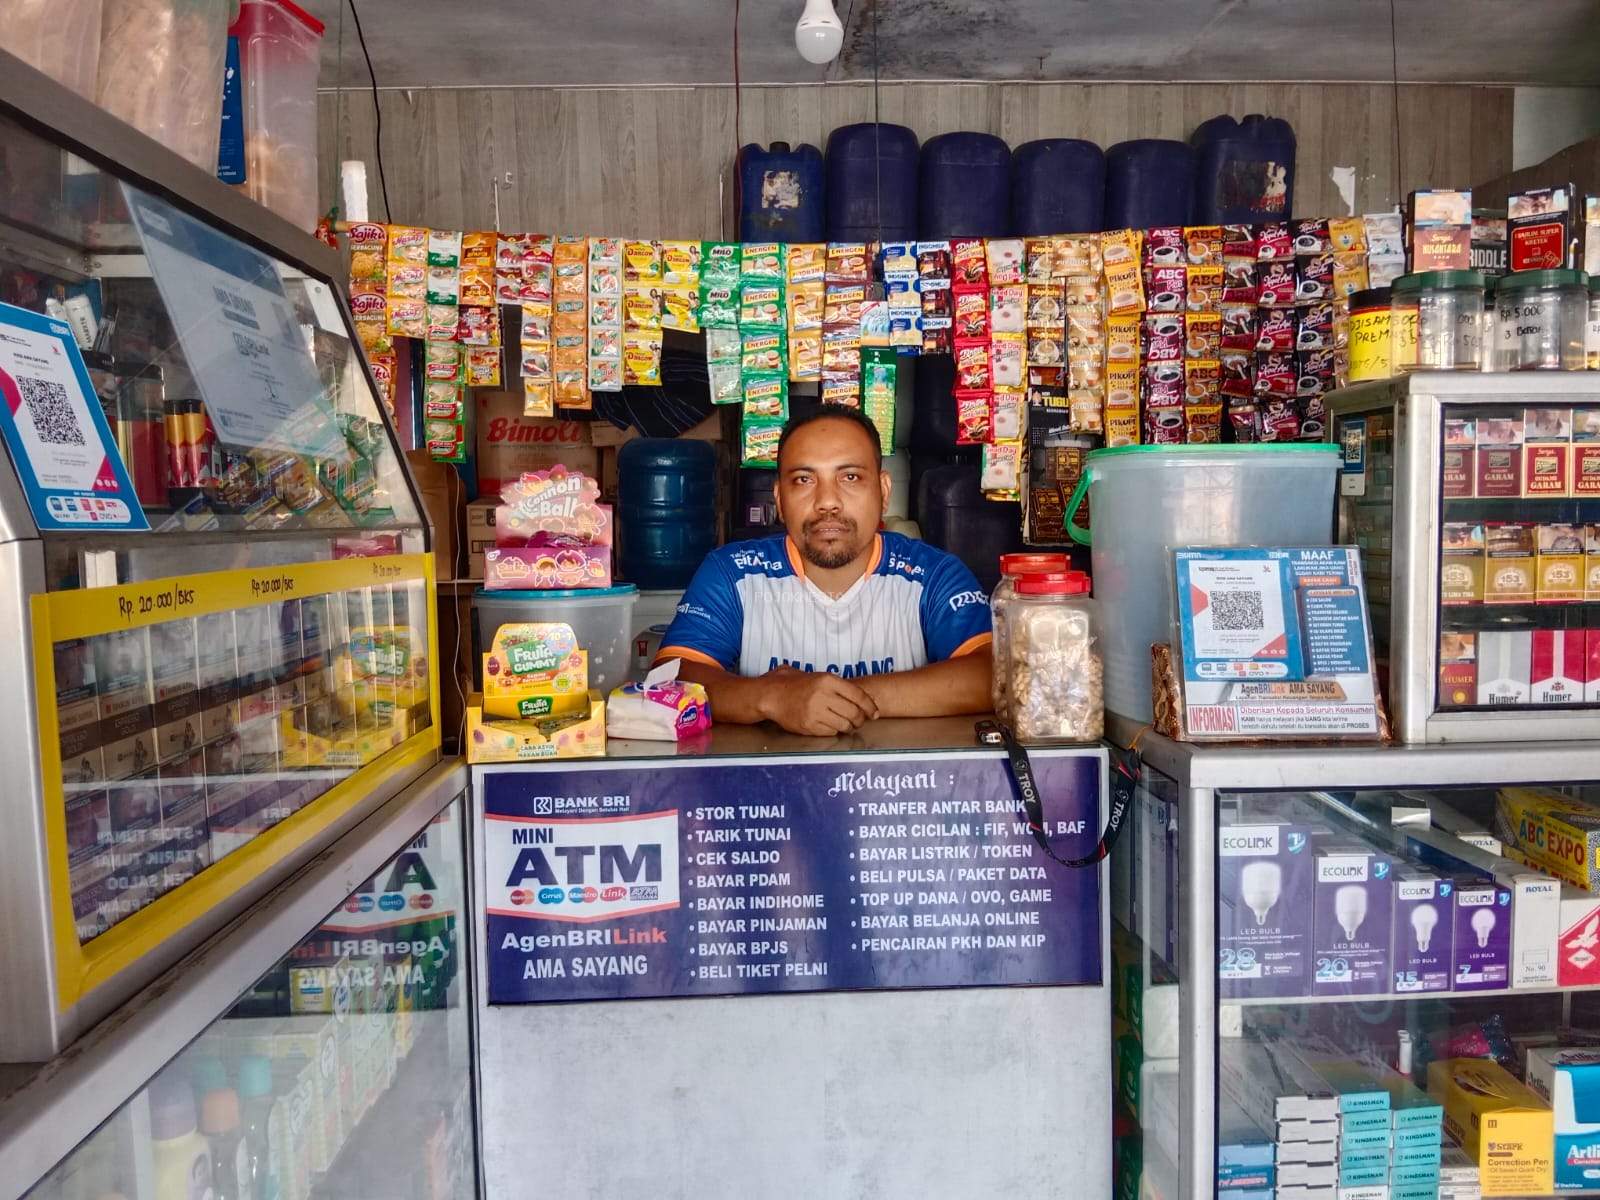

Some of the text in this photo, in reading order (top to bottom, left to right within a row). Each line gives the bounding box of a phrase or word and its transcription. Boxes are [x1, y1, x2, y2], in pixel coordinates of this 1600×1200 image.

[351, 228, 385, 243] Sajiku
[1191, 230, 1220, 239] ABC
[745, 246, 777, 255] ENERGEN
[832, 247, 863, 255] ENERGEN
[1156, 269, 1185, 279] ABC
[1191, 275, 1221, 285] ABC
[745, 293, 777, 302] ENERGEN
[352, 298, 386, 313] Sajiku
[1190, 322, 1218, 332] ABC
[746, 340, 778, 349] ENERGEN
[827, 339, 859, 347] ENERGEN
[1190, 369, 1218, 379] ABC
[747, 386, 779, 396] ENERGEN
[487, 417, 582, 443] Bimoli
[1530, 481, 1561, 489] GARAM
[1301, 551, 1334, 560] MAAF
[1307, 683, 1335, 694] SAYANG
[1190, 707, 1235, 733] INFORMASI
[828, 770, 937, 797] Melayani
[1018, 773, 1036, 804] TROY
[555, 796, 630, 808] BANK BRI
[860, 800, 1026, 816] TRANFER ANTAR BANK
[695, 805, 785, 820] STOR TUNAI
[1110, 801, 1125, 831] TROY
[513, 828, 553, 844] MINI
[696, 828, 791, 842] TARIK TUNAI
[860, 821, 1085, 838] BAYAR CICILAN FIF, BAF
[1519, 819, 1585, 865] ABC EXPO
[696, 851, 780, 865] CEK SALDO
[860, 845, 1032, 861] BAYAR LISTRIK TOKEN
[506, 844, 661, 886] ATM
[697, 873, 791, 888] BAYAR PDAM
[860, 866, 1047, 884] BELI PULSA PAKET DATA
[698, 895, 824, 911] BAYAR INDIHOME
[860, 889, 1052, 906] TOP UP DANA OVO, GAME
[698, 917, 827, 933] BAYAR PINJAMAN
[861, 912, 1040, 929] BAYAR BELANJA ONLINE
[501, 928, 667, 952] AgenBRILink
[862, 935, 1046, 952] PENCAIRAN PKH DAN KIP
[699, 941, 788, 956] BAYAR BPJS
[523, 955, 648, 979] AMA SAYANG
[700, 963, 827, 978] BELI TIKET PELNI
[1317, 958, 1348, 978] 20
[1396, 972, 1417, 983] 15
